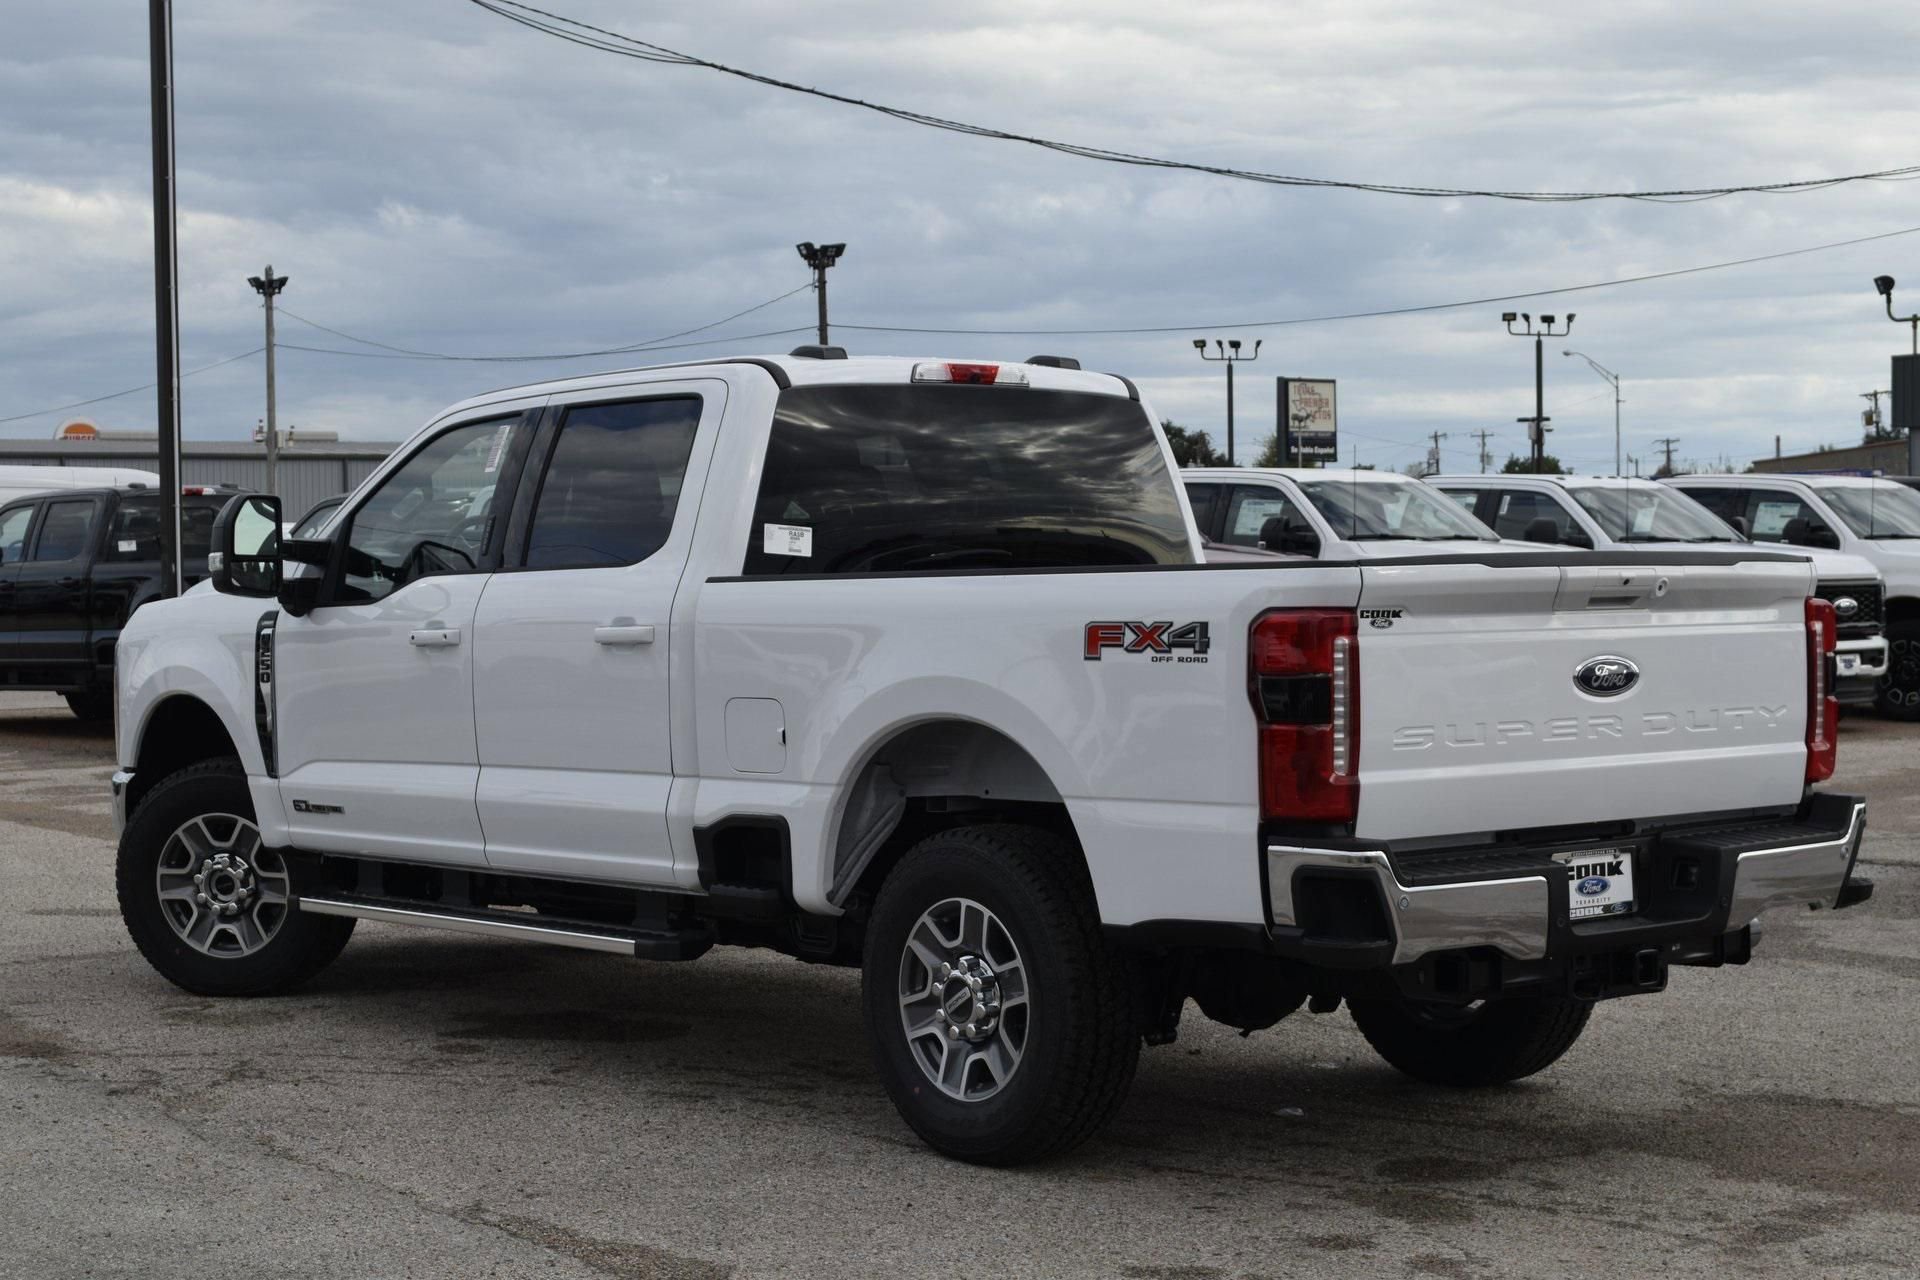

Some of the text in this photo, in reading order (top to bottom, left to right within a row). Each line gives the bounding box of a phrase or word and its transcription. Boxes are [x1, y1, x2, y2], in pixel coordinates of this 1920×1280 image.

[1360, 609, 1403, 619] COOK
[1084, 621, 1210, 661] FX4
[1591, 664, 1626, 687] Ford
[1392, 704, 1788, 752] SUPER DUTY
[1583, 880, 1602, 894] Ford
